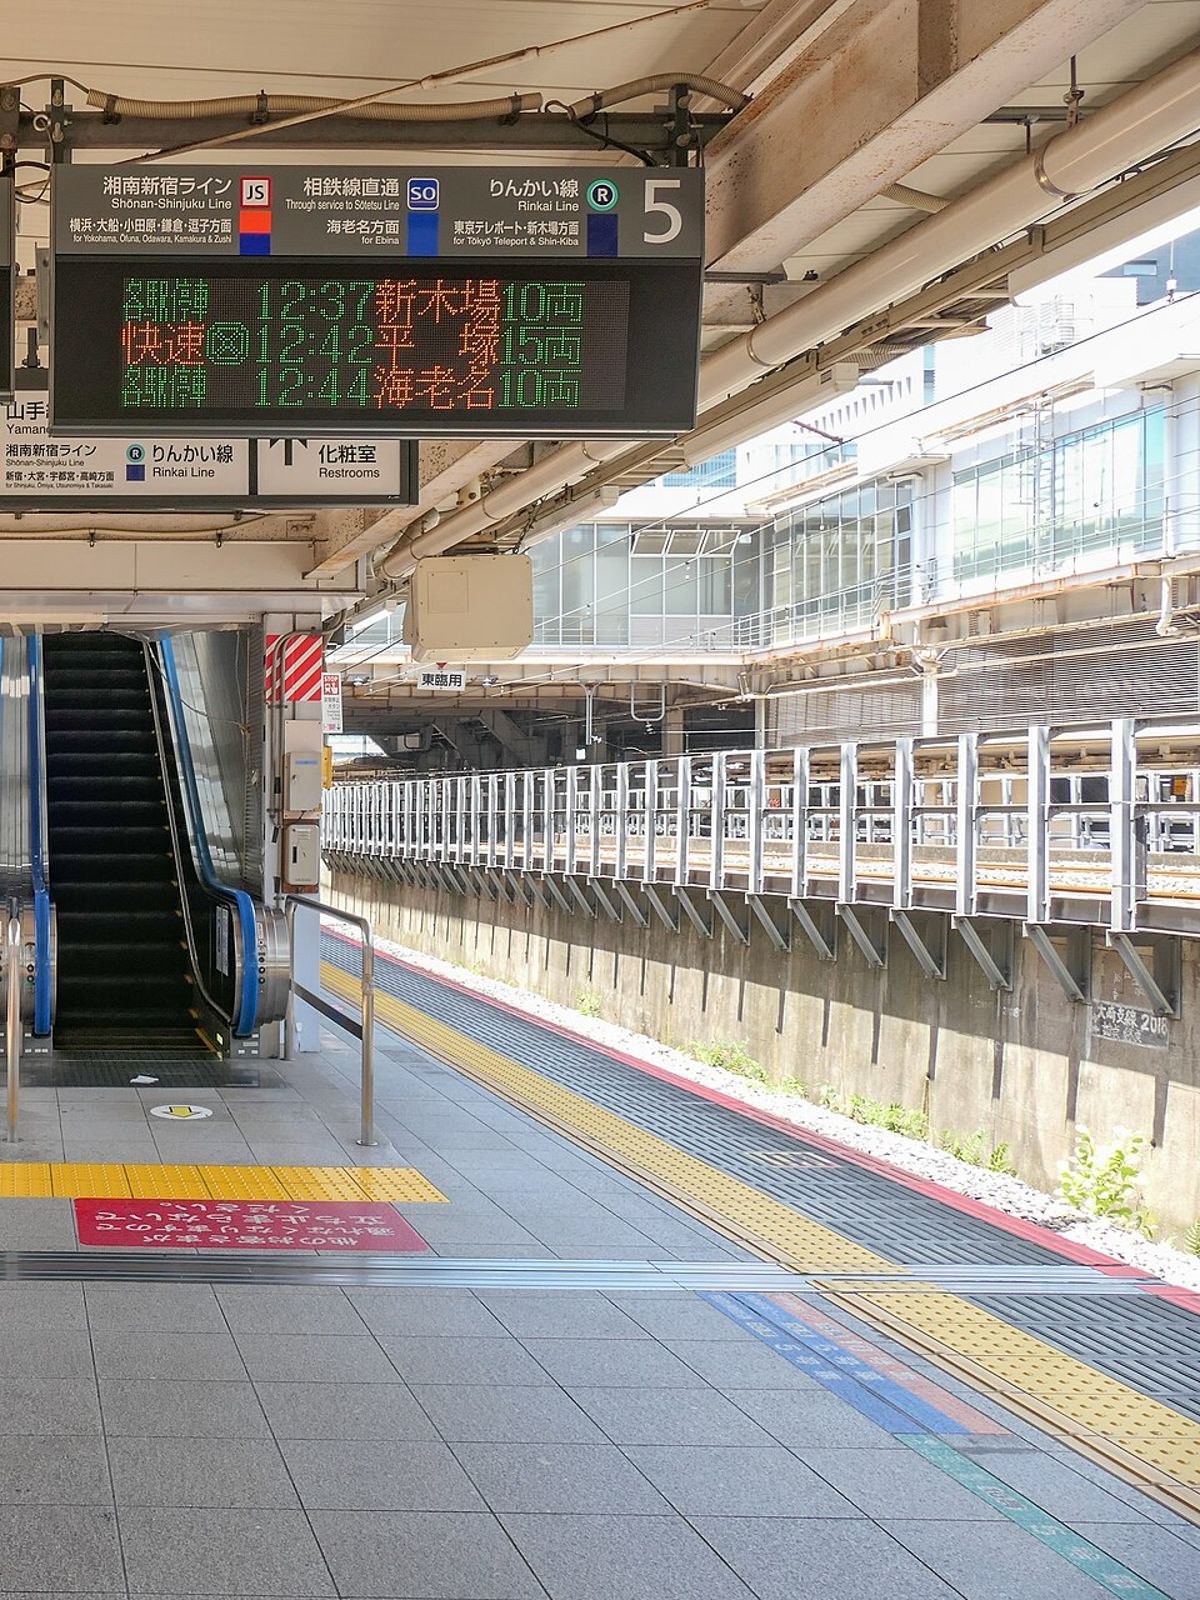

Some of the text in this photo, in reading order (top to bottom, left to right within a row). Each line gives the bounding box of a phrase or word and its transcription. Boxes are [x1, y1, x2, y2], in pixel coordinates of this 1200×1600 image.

[103, 176, 232, 195] 湘南新宿ライン
[246, 185, 265, 200] JS
[304, 177, 400, 197] 相鉄線直通
[490, 179, 579, 198] りんかい線
[410, 186, 436, 201] SO
[597, 188, 609, 202] R
[111, 198, 232, 211] Shōnan-Shinjuku Line
[286, 199, 317, 212] Through
[318, 200, 344, 210] service
[345, 200, 352, 210] to
[384, 200, 400, 210] Line
[518, 201, 579, 211] Rinkai Line
[643, 179, 683, 244] 5
[69, 218, 232, 233] 横浜・大船・小田原・鎌倉・逗子方面
[327, 219, 400, 235] 海老名方面
[454, 220, 579, 235] 東京テレポート・新木場方面
[84, 235, 119, 244] Yokohama,
[174, 235, 206, 243] Kamakura
[207, 235, 213, 243] &
[214, 235, 232, 243] Zushi
[362, 236, 400, 245] for Ebina
[453, 237, 464, 245] for
[494, 237, 528, 247] Teleport
[529, 237, 536, 245] &
[538, 237, 579, 246] Shin-Kiba
[257, 282, 375, 320] 12:37
[375, 280, 501, 325] 新木場
[501, 283, 586, 322] 10両
[122, 321, 205, 364] 快速
[255, 323, 374, 363] 12:42
[500, 326, 584, 365] 15両
[255, 367, 372, 406] 12:44
[373, 366, 496, 410] 海老名
[498, 369, 582, 408] 10両
[6, 401, 49, 420] 山手
[6, 444, 97, 457] 湘南新宿ライン
[132, 449, 140, 458] R
[152, 444, 234, 463] りんかい線
[318, 444, 376, 464] 化粧室
[69, 459, 85, 467] Line
[6, 471, 115, 482] 新宿・大宮・宇都宮・高崎方面
[153, 467, 215, 478] Rinkai Line
[319, 467, 380, 478] Restrooms
[421, 673, 463, 687] 東臨用
[159, 1202, 310, 1214] ください。
[95, 1212, 387, 1225] 立ち止まらないで
